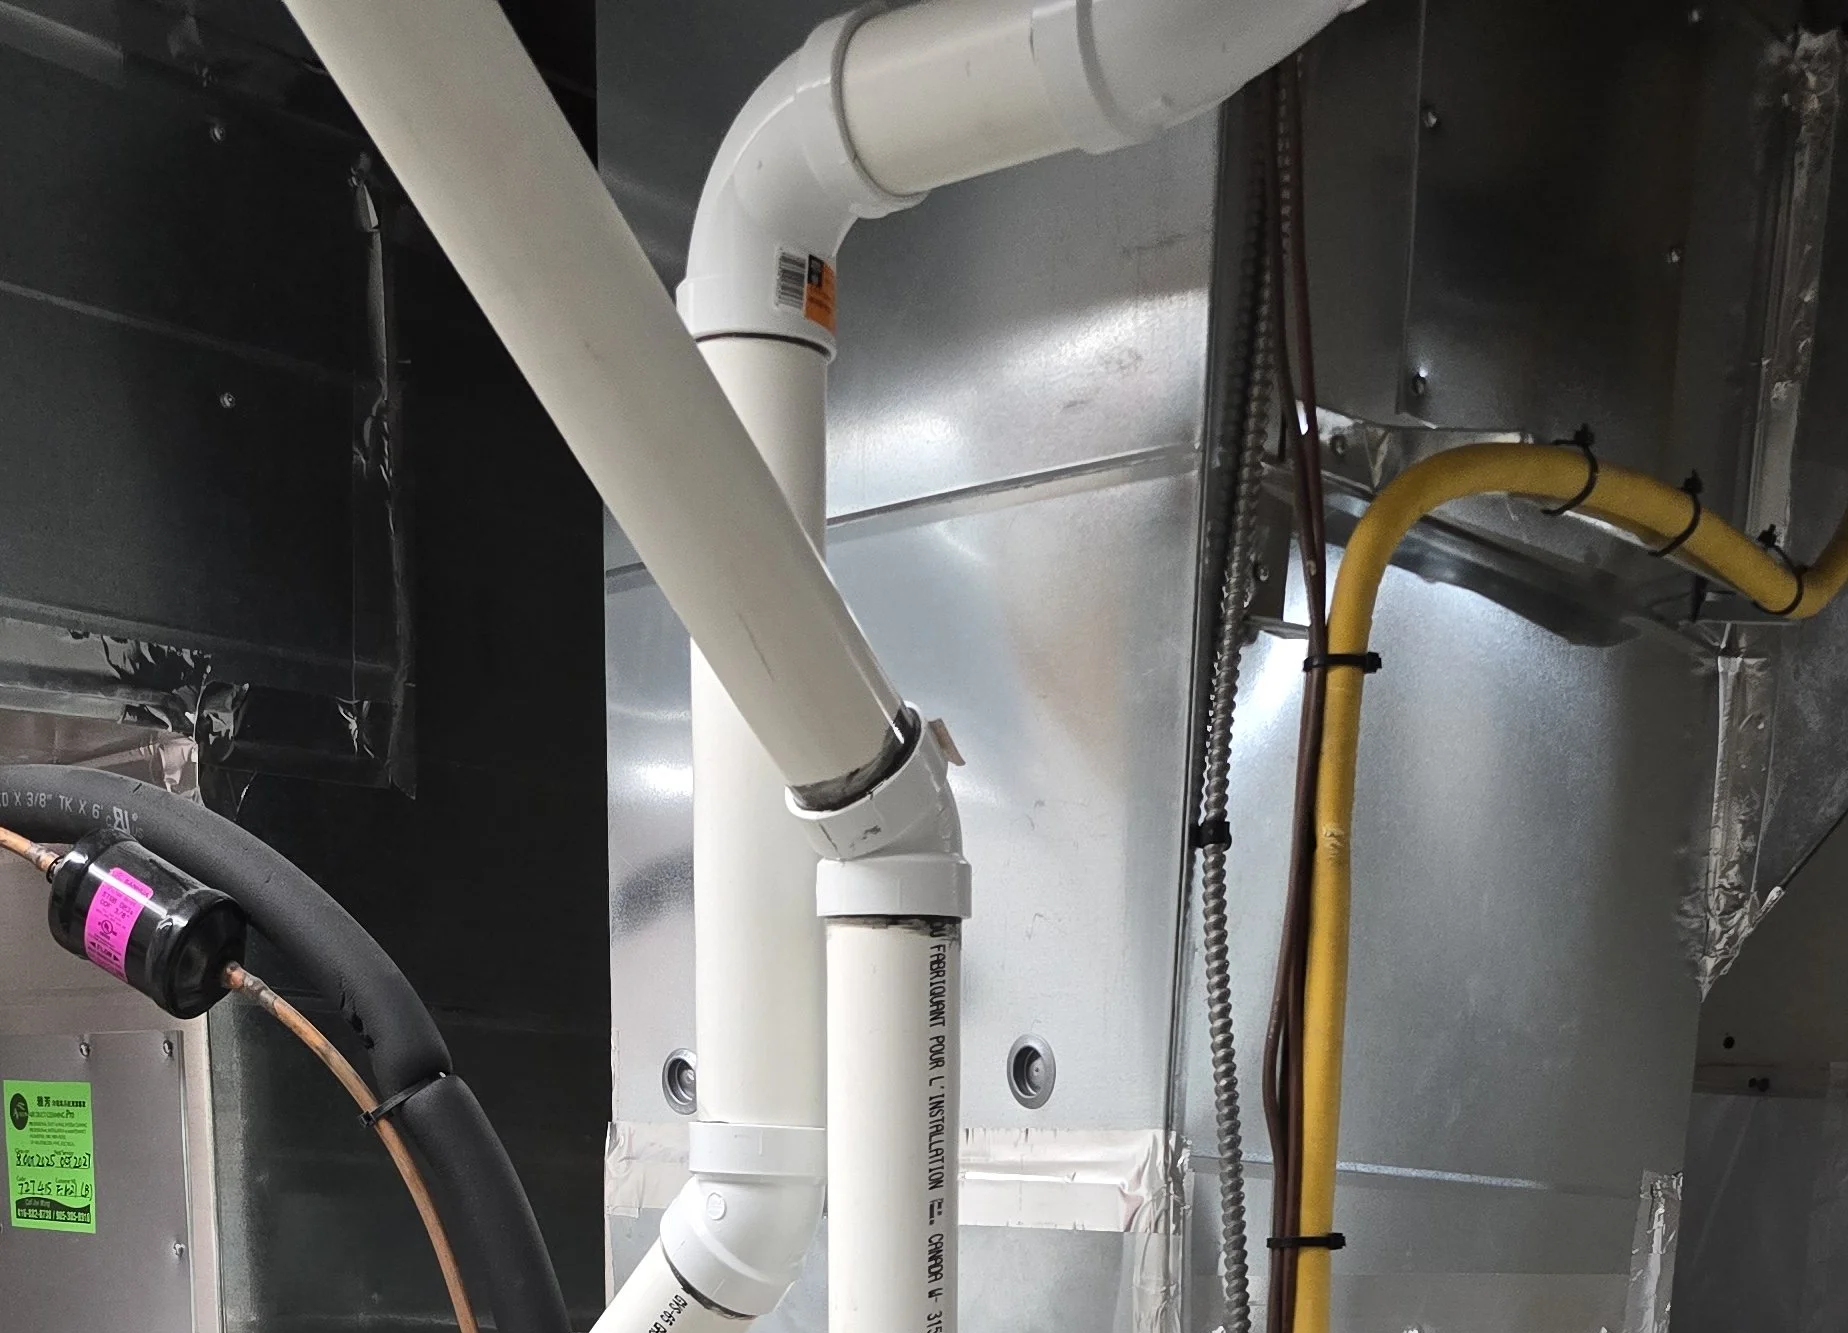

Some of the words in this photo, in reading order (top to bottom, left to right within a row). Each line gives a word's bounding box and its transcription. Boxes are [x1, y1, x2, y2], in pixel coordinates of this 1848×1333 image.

[14, 793, 22, 807] X
[59, 795, 73, 812] TK
[79, 800, 87, 816] X
[930, 944, 946, 1028] FABRIQUANT
[929, 1035, 945, 1070] POUR
[928, 1234, 944, 1284] CANADA
